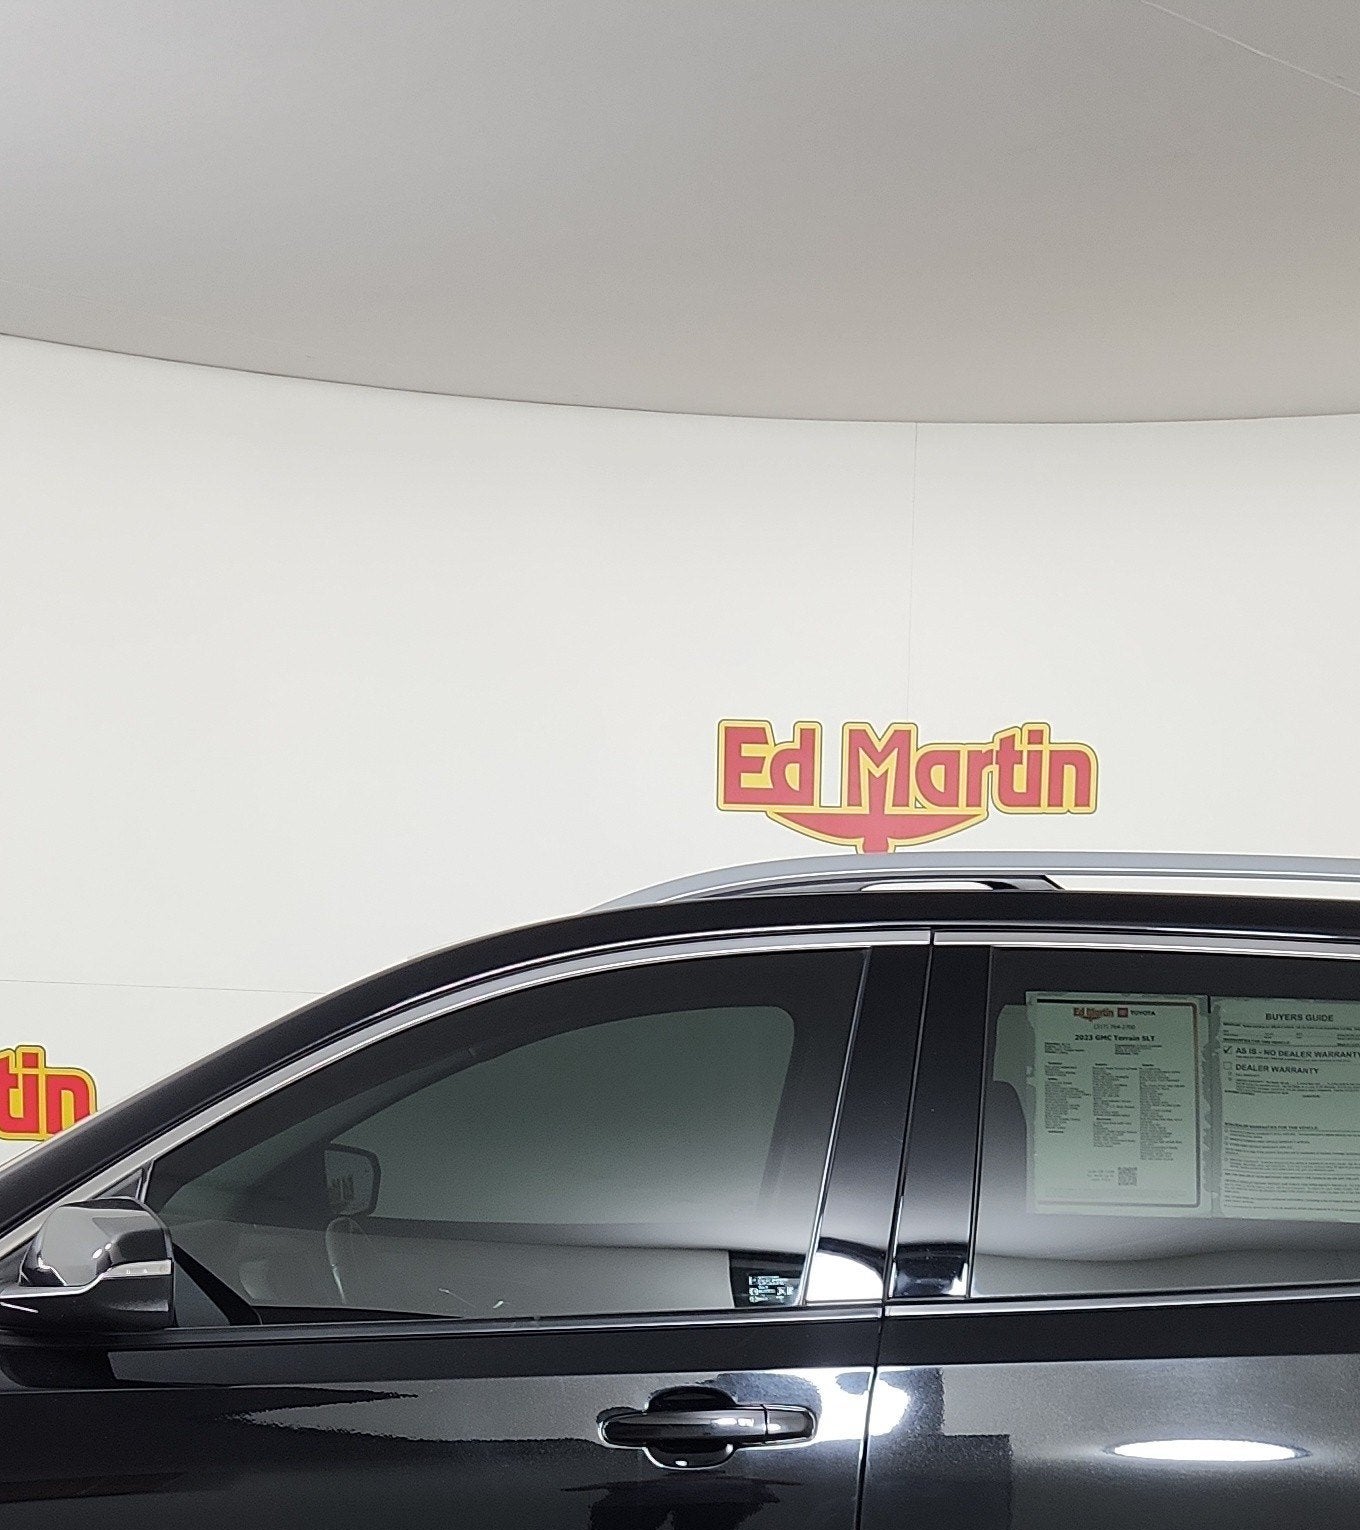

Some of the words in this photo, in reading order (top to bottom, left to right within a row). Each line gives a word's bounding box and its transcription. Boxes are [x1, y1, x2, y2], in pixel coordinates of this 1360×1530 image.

[720, 723, 817, 808] Ed
[844, 725, 1094, 811] Martin
[1265, 1012, 1303, 1021] BUYERS
[1305, 1013, 1334, 1022] GUIDE
[1113, 1034, 1140, 1042] Terrain
[1235, 1047, 1247, 1055] AS
[1248, 1047, 1257, 1055] IS
[1278, 1050, 1312, 1058] DEALER
[1235, 1064, 1270, 1072] DEALER
[1271, 1065, 1319, 1074] WARRANTY
